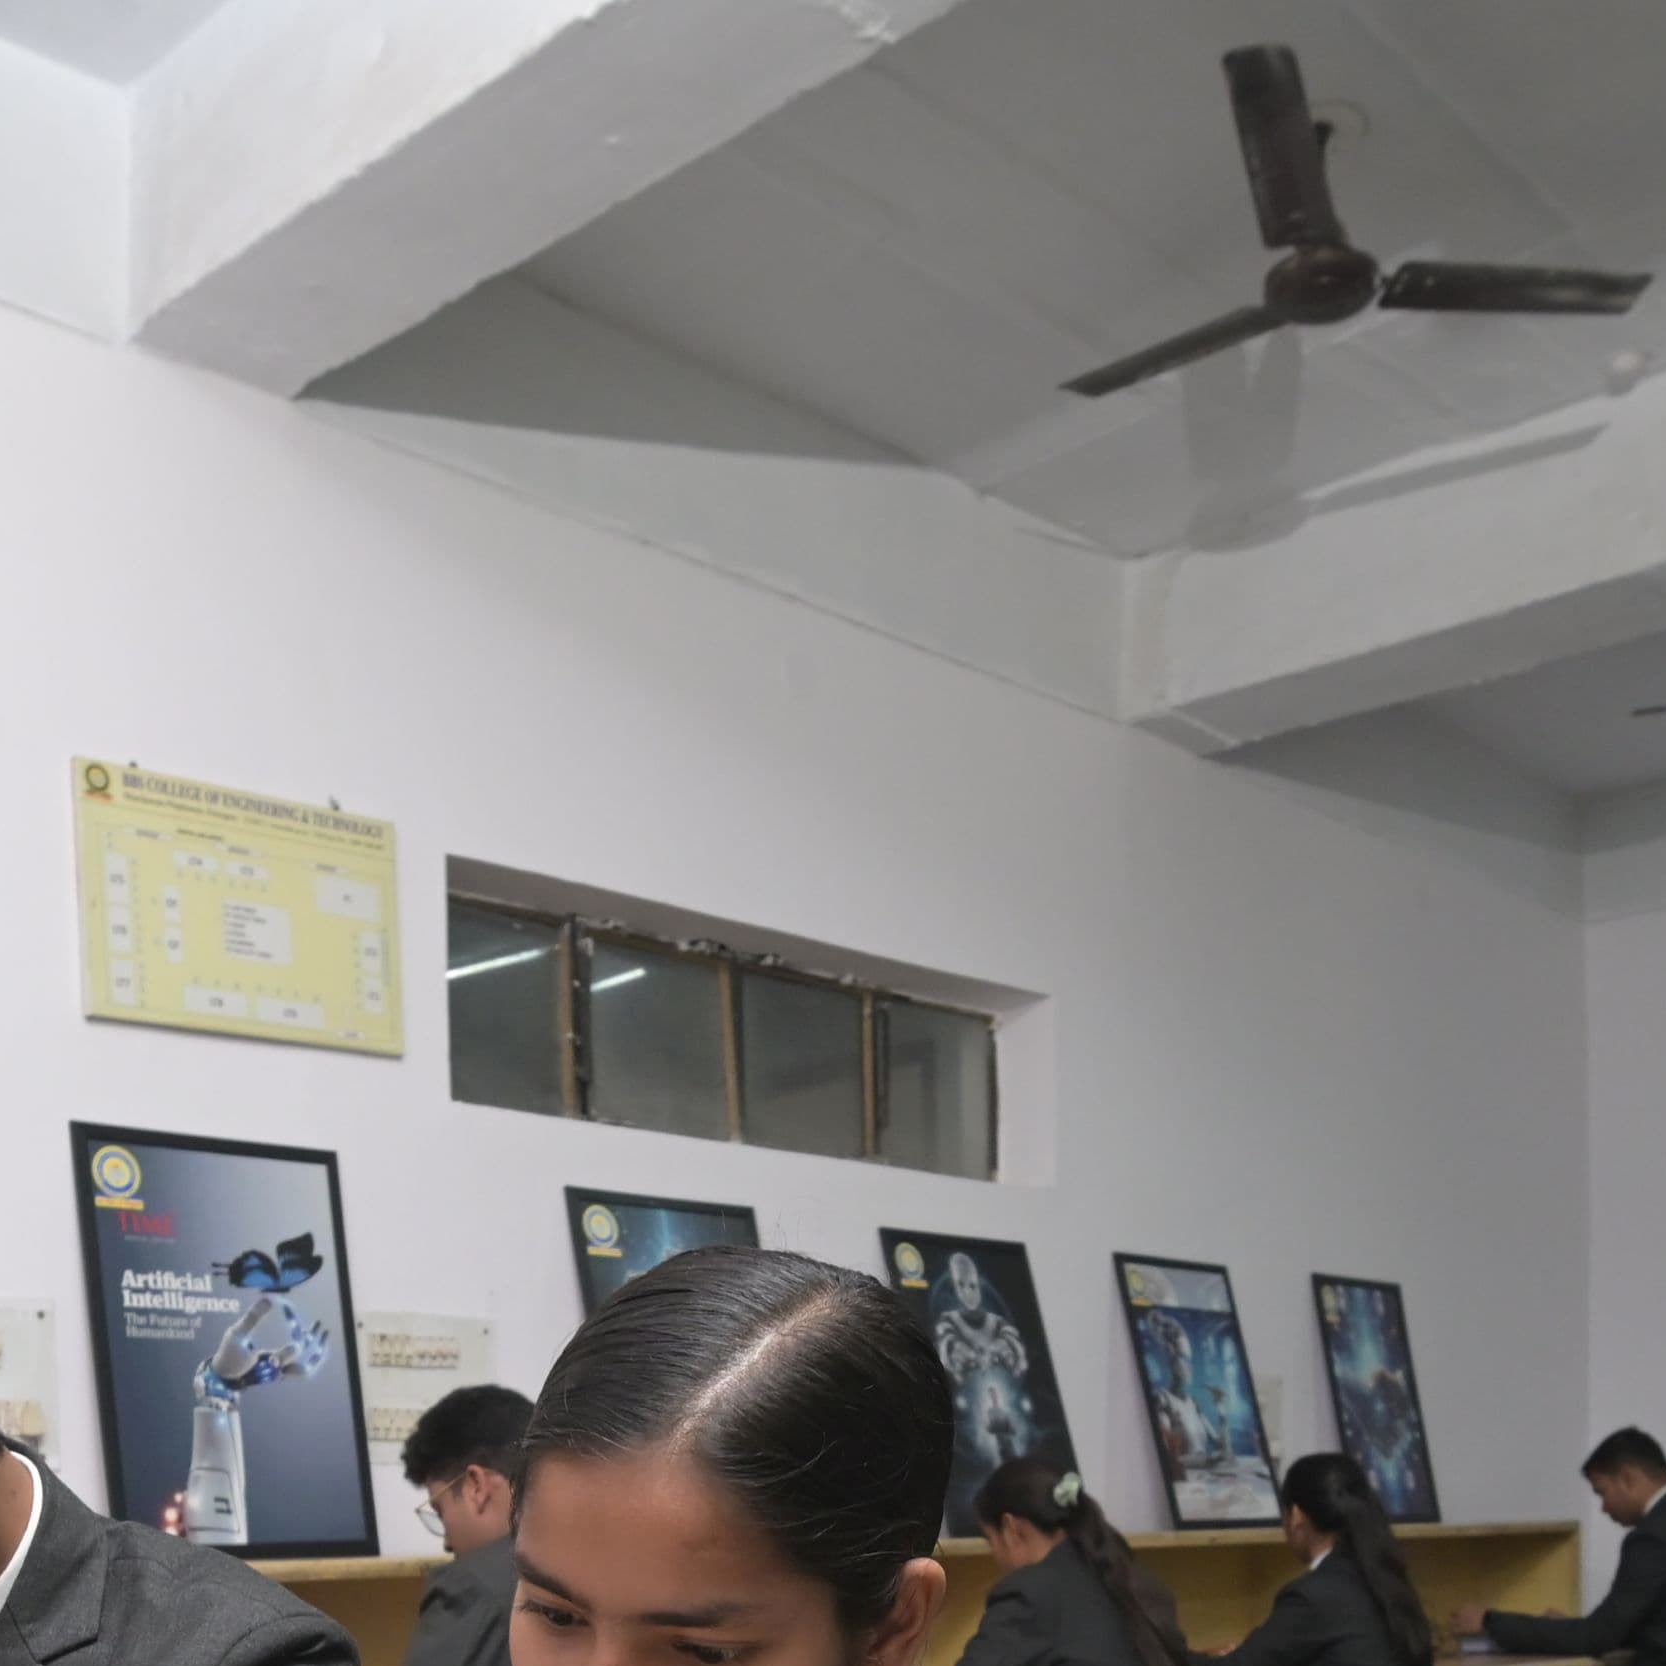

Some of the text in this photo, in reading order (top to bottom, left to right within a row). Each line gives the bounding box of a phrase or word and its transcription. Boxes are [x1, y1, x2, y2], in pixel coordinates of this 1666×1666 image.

[147, 776, 201, 802] COLLEGE
[205, 790, 221, 805] OF
[221, 792, 298, 822] ENGINEERING
[312, 811, 384, 839] TECHNOLOGY
[117, 1211, 178, 1238] TIME
[121, 1269, 212, 1293] Artificial
[123, 1289, 241, 1314] Intelligence
[124, 1312, 203, 1329] The Future of
[125, 1325, 196, 1341] Humankind
